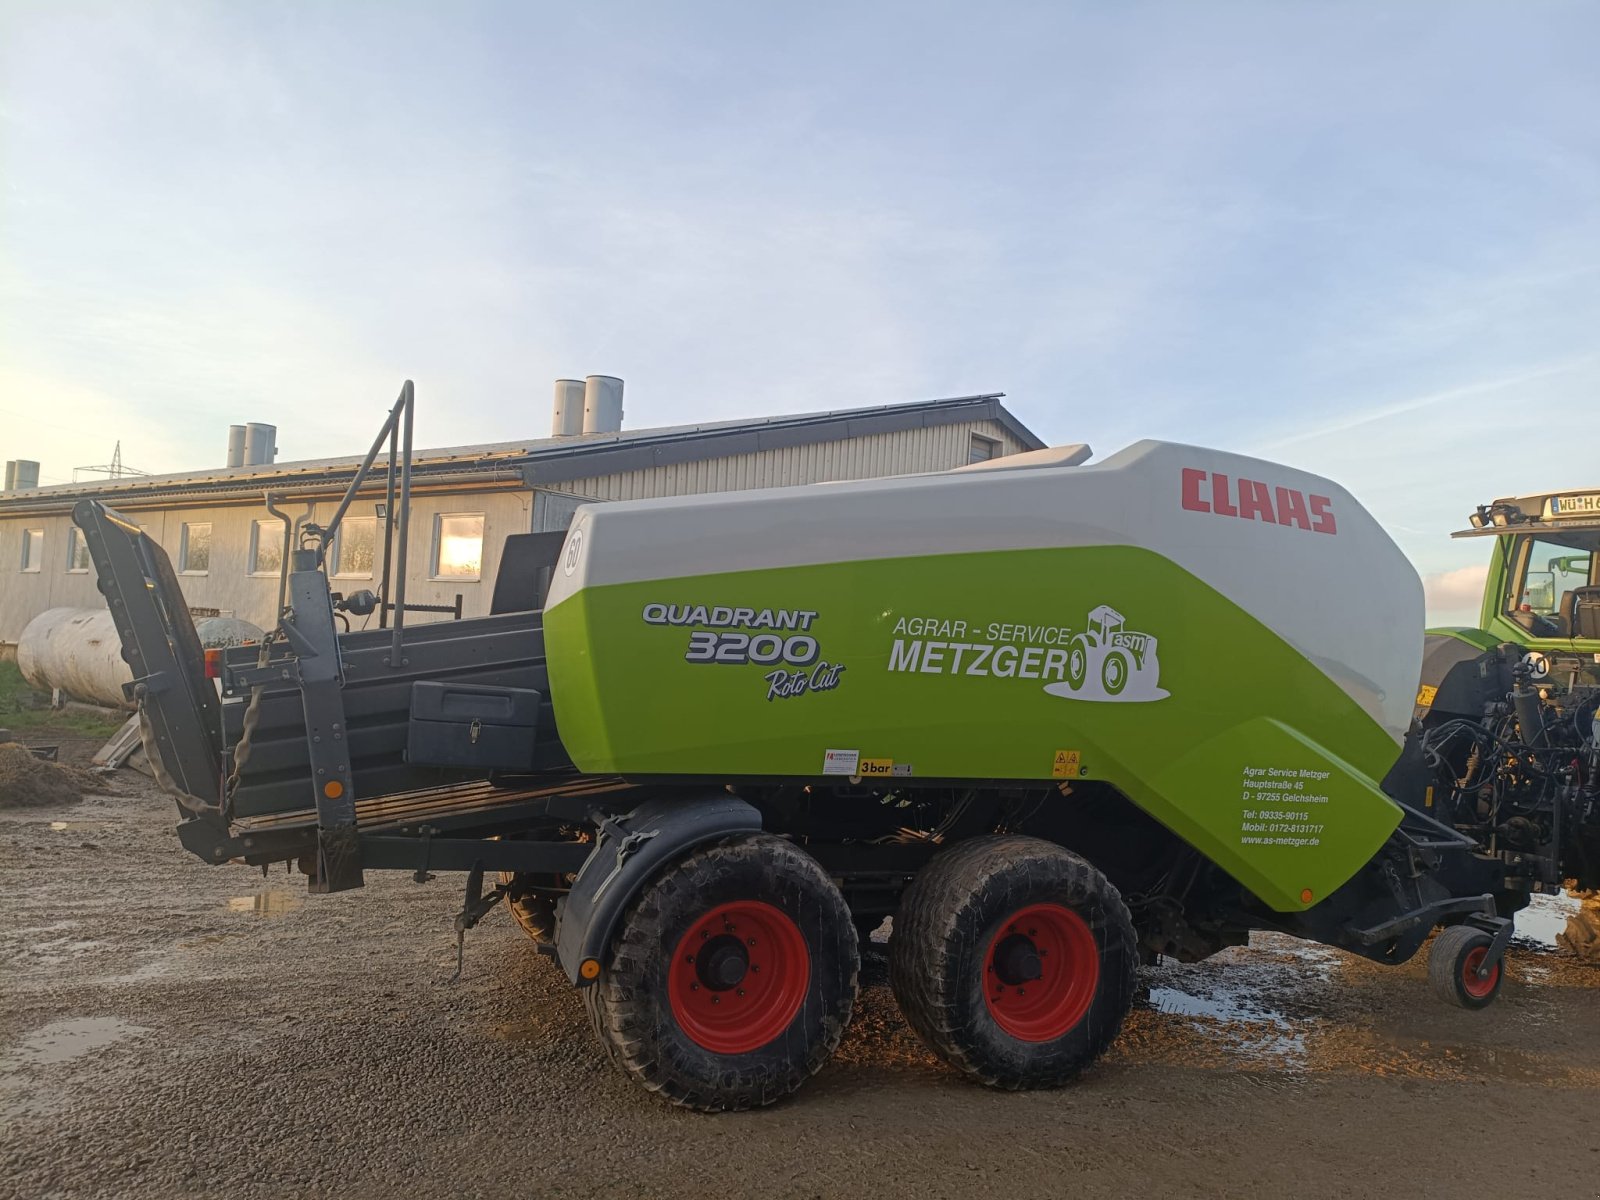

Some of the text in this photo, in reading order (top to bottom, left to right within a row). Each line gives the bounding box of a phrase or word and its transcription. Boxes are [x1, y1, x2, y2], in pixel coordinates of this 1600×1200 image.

[1181, 467, 1337, 535] CLAAS
[1559, 498, 1576, 511] WÜ
[566, 537, 582, 569] 60
[642, 603, 819, 631] QUADRANT
[893, 617, 967, 638] AGRAR
[986, 623, 1071, 645] SERVICE
[685, 631, 820, 666] 3200
[1114, 634, 1145, 652] asm
[888, 639, 1069, 680] METZGER
[764, 661, 846, 701] Roto Cut
[861, 762, 869, 773] 3
[870, 762, 890, 773] bar
[1243, 767, 1330, 780] Agrar Service Metzger
[1243, 779, 1304, 790] Hauptstraße 45
[1243, 791, 1250, 800] D
[1242, 810, 1309, 821] Tel: 09335-90115
[1241, 822, 1268, 832] Mobil:
[1241, 836, 1320, 847] www.as-metzger.de
